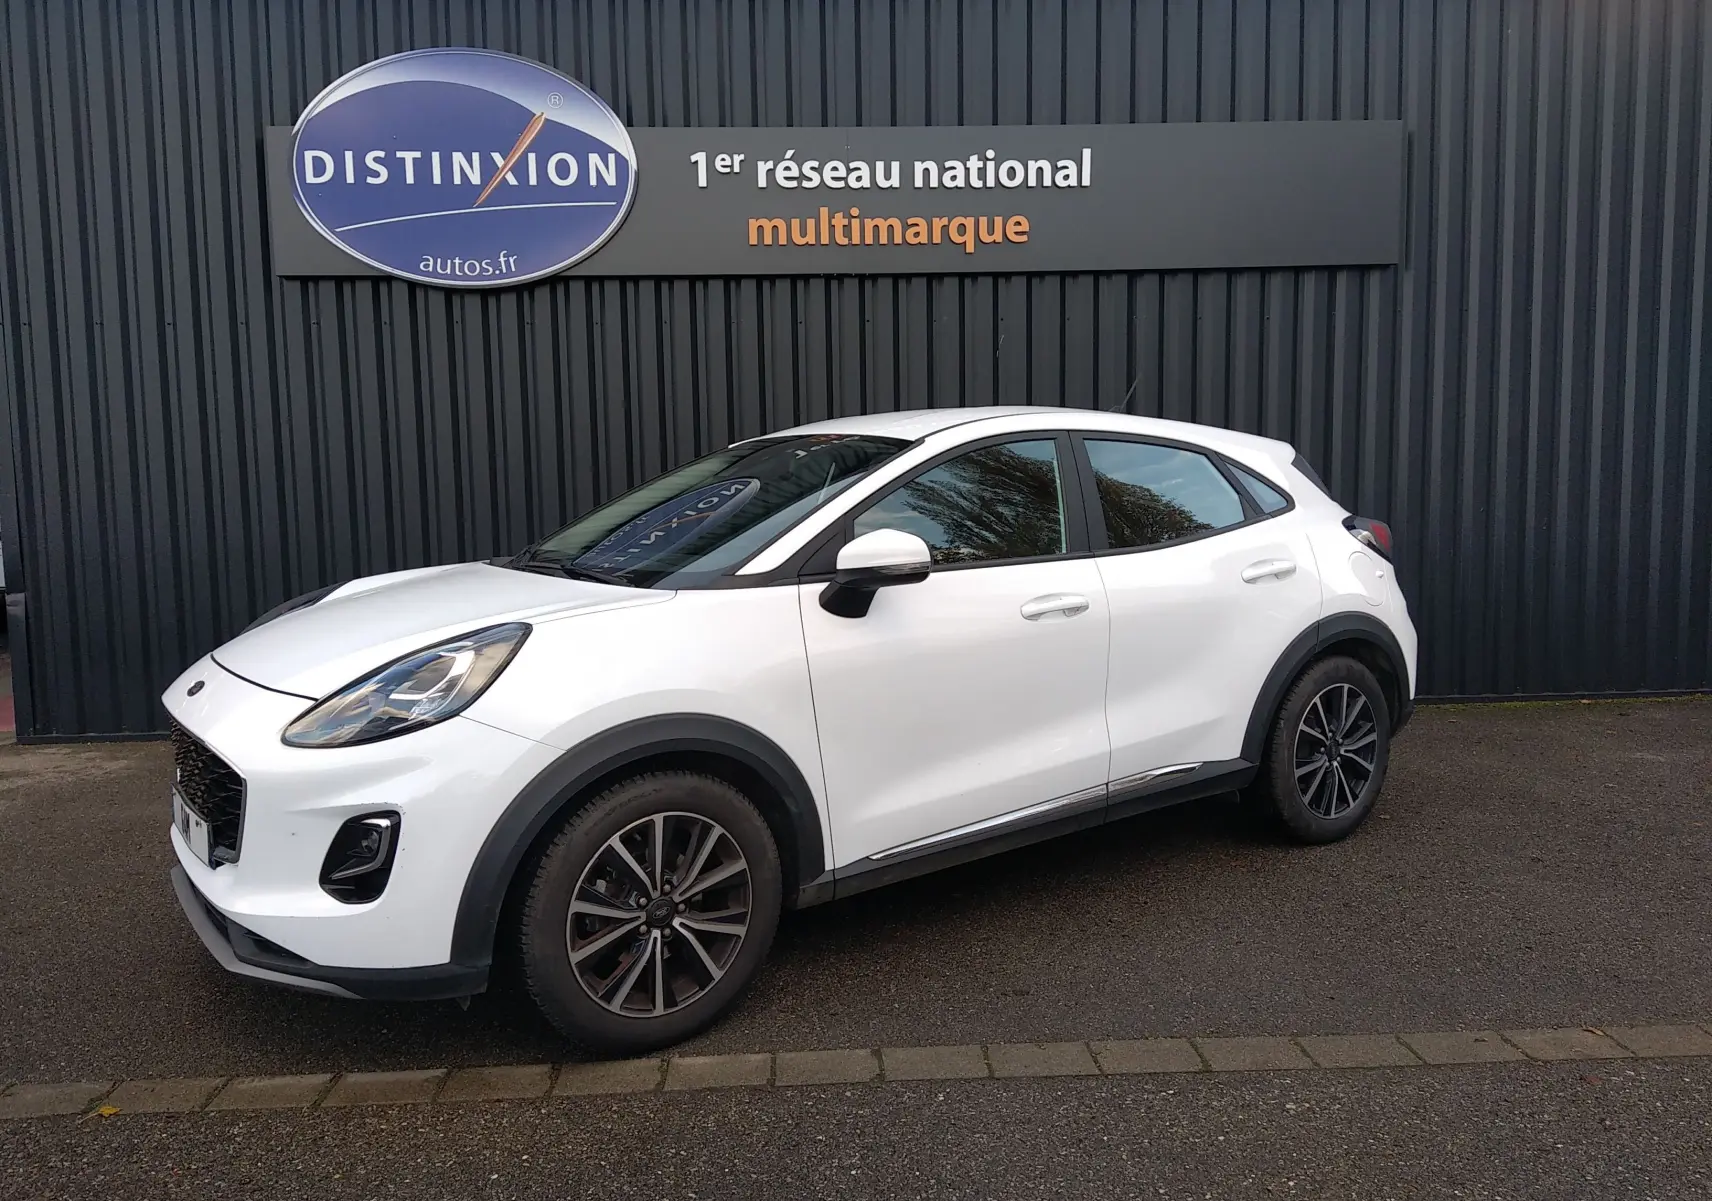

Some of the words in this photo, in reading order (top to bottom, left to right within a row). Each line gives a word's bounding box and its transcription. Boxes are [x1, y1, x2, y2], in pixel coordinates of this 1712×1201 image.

[303, 150, 617, 186] DISTINXION
[690, 150, 744, 188] 1er
[756, 149, 901, 189] réseau
[913, 147, 1092, 188] national
[747, 206, 1030, 253] multimarque
[418, 250, 518, 276] autos.fr
